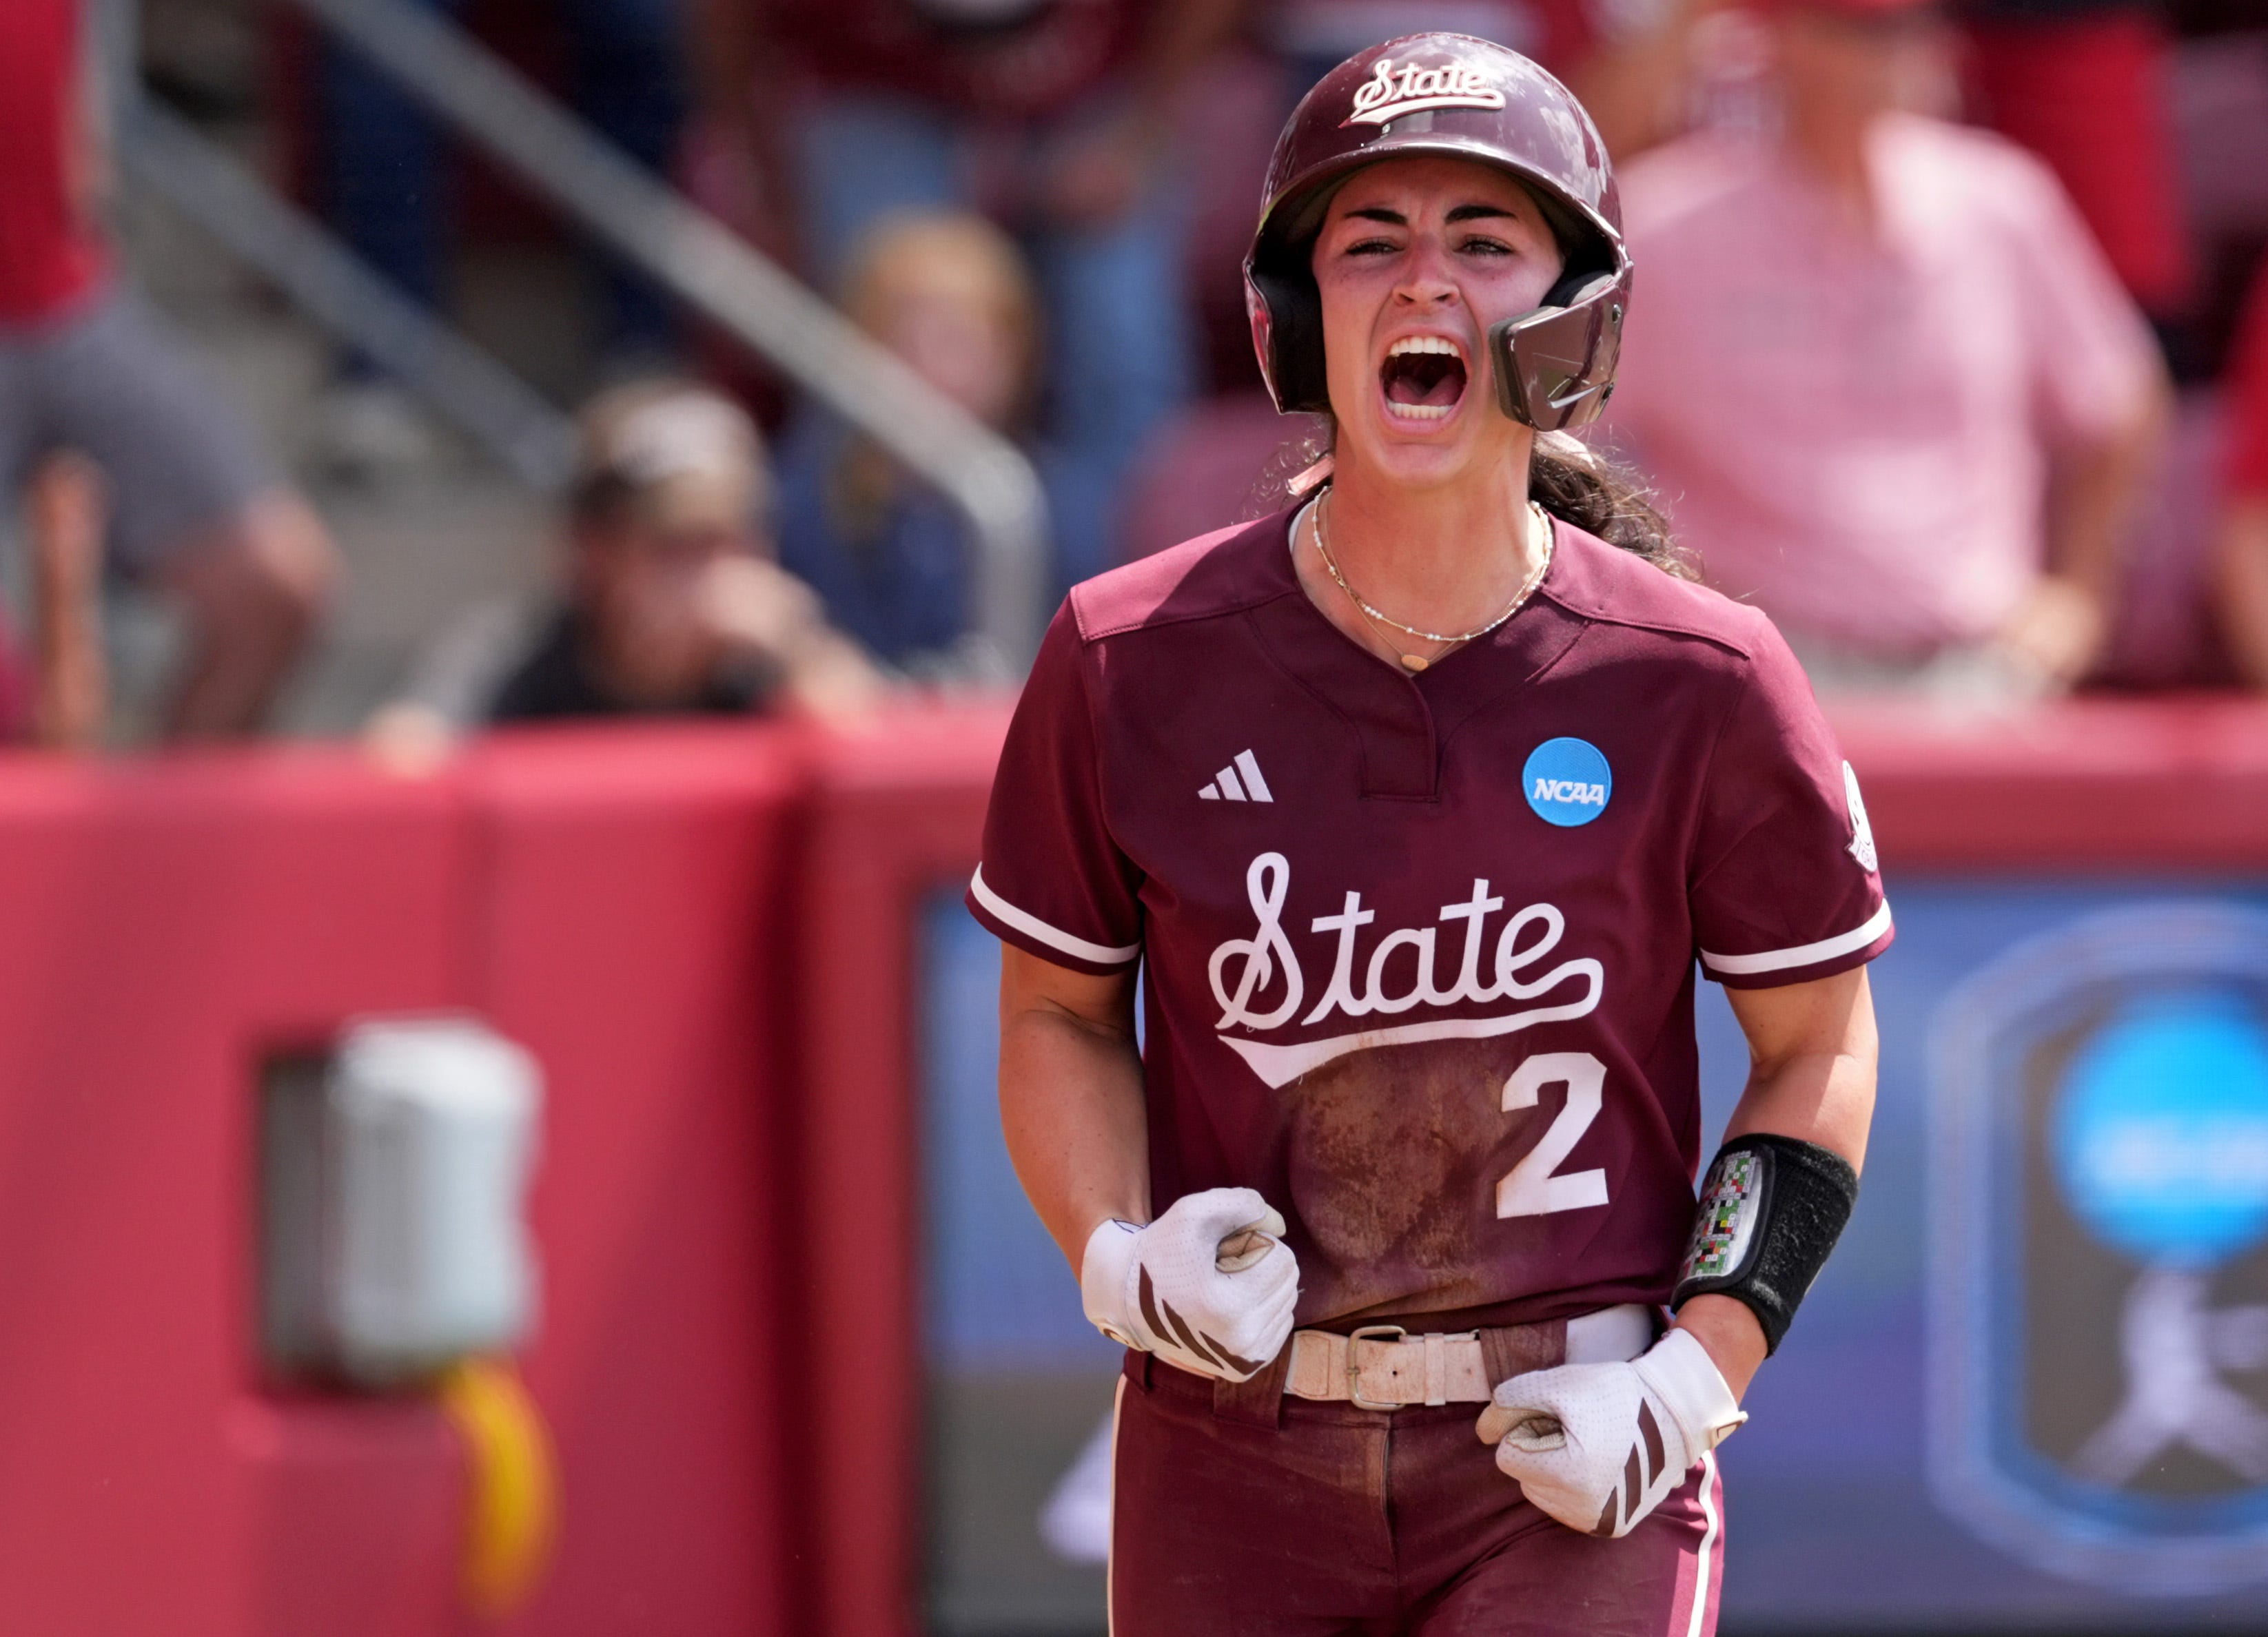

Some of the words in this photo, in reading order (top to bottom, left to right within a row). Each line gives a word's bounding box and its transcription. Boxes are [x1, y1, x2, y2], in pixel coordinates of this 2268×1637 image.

[1349, 59, 1506, 124] State
[1533, 778, 1605, 805] NCAA
[1208, 852, 1604, 1089] State
[1496, 1052, 1608, 1219] 2
